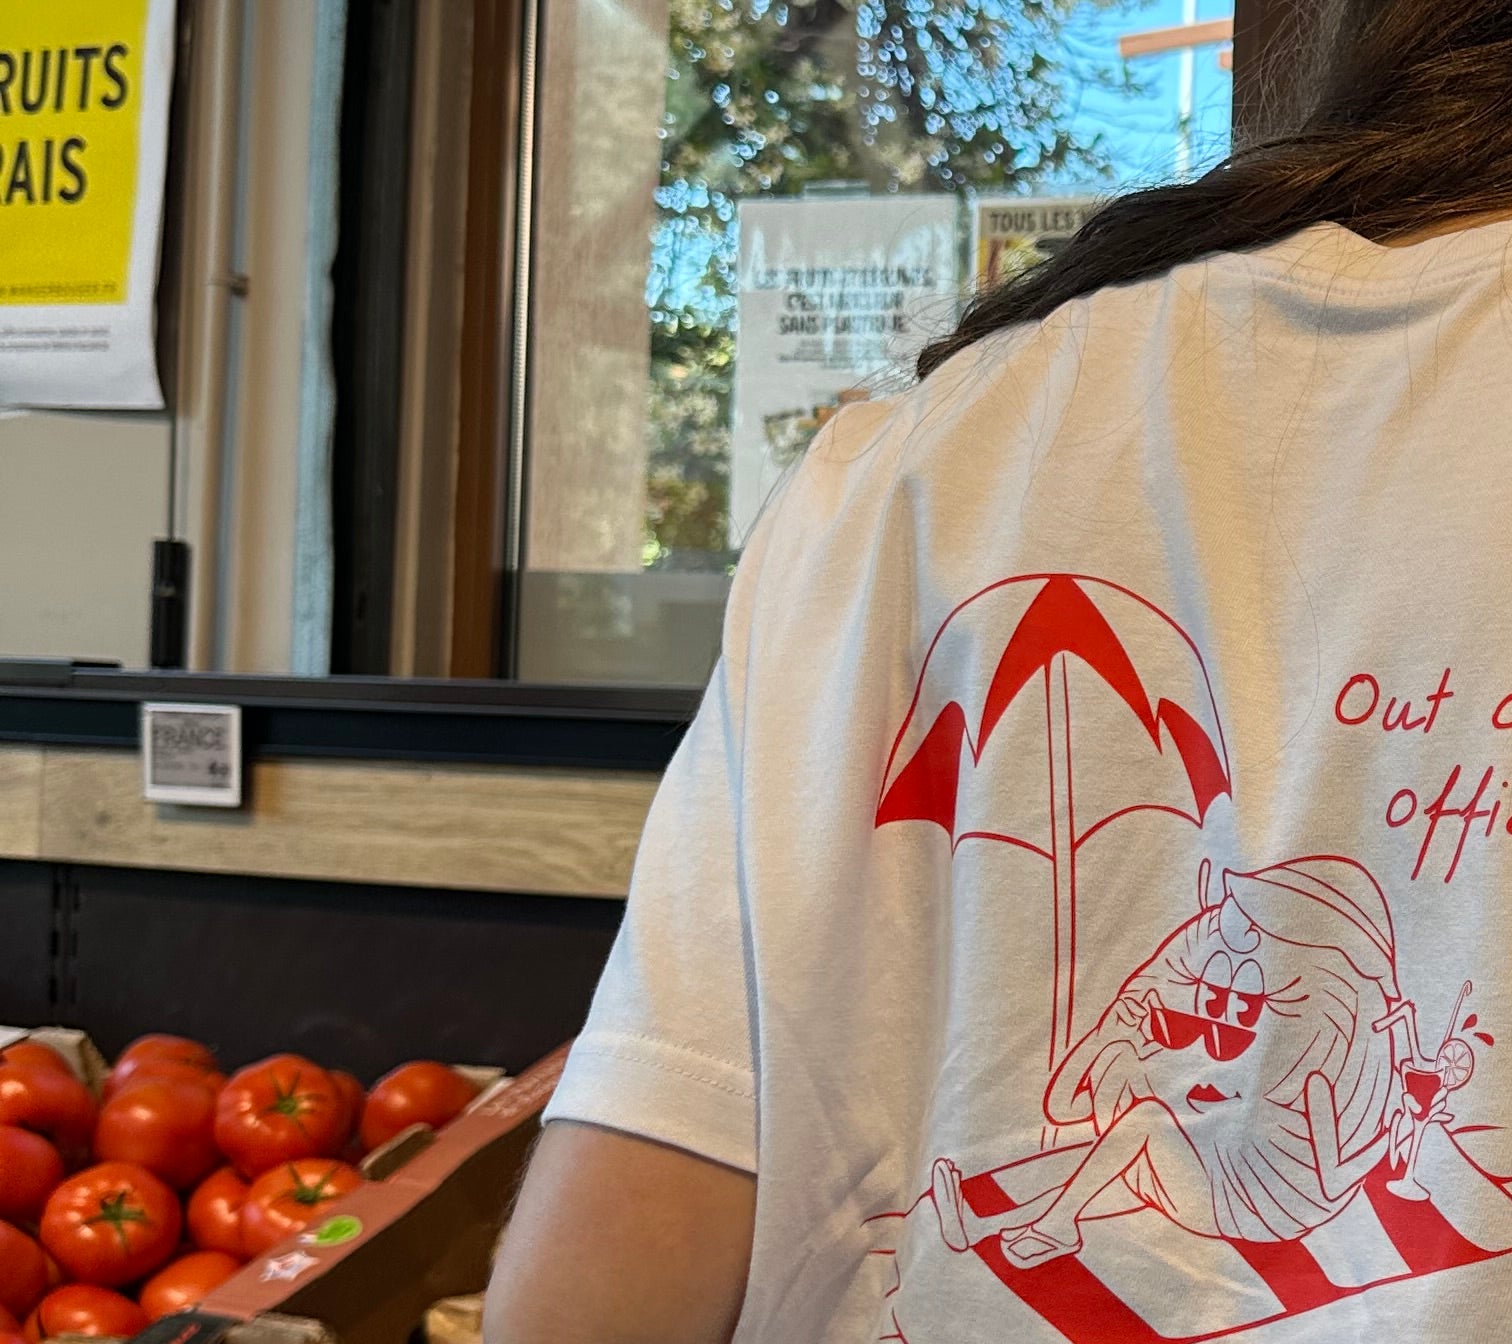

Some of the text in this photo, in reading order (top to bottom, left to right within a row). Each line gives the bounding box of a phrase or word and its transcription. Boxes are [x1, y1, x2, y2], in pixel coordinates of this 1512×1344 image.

[0, 45, 129, 114] RUITS
[0, 138, 86, 204] AIS
[990, 211, 1037, 232] TOUS
[1043, 211, 1075, 232] LES
[1335, 668, 1454, 733] Out
